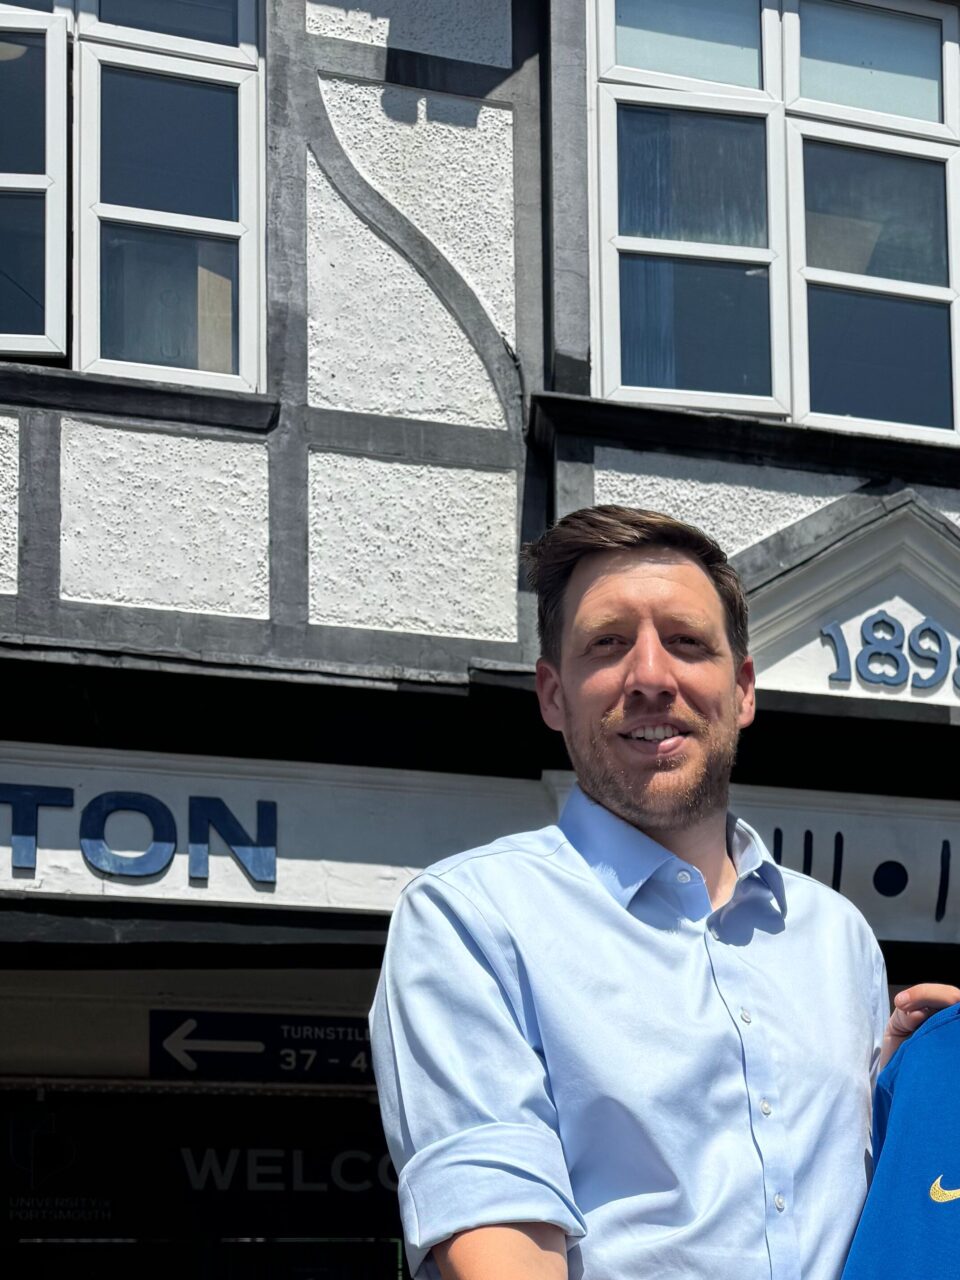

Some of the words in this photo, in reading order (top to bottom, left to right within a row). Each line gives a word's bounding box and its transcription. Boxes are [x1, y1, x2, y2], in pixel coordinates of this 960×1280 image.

[0, 783, 277, 883] TON
[280, 1048, 317, 1071] 37
[8, 1196, 96, 1208] UNIVERSITY
[8, 1209, 112, 1221] PORTSMOUTH
